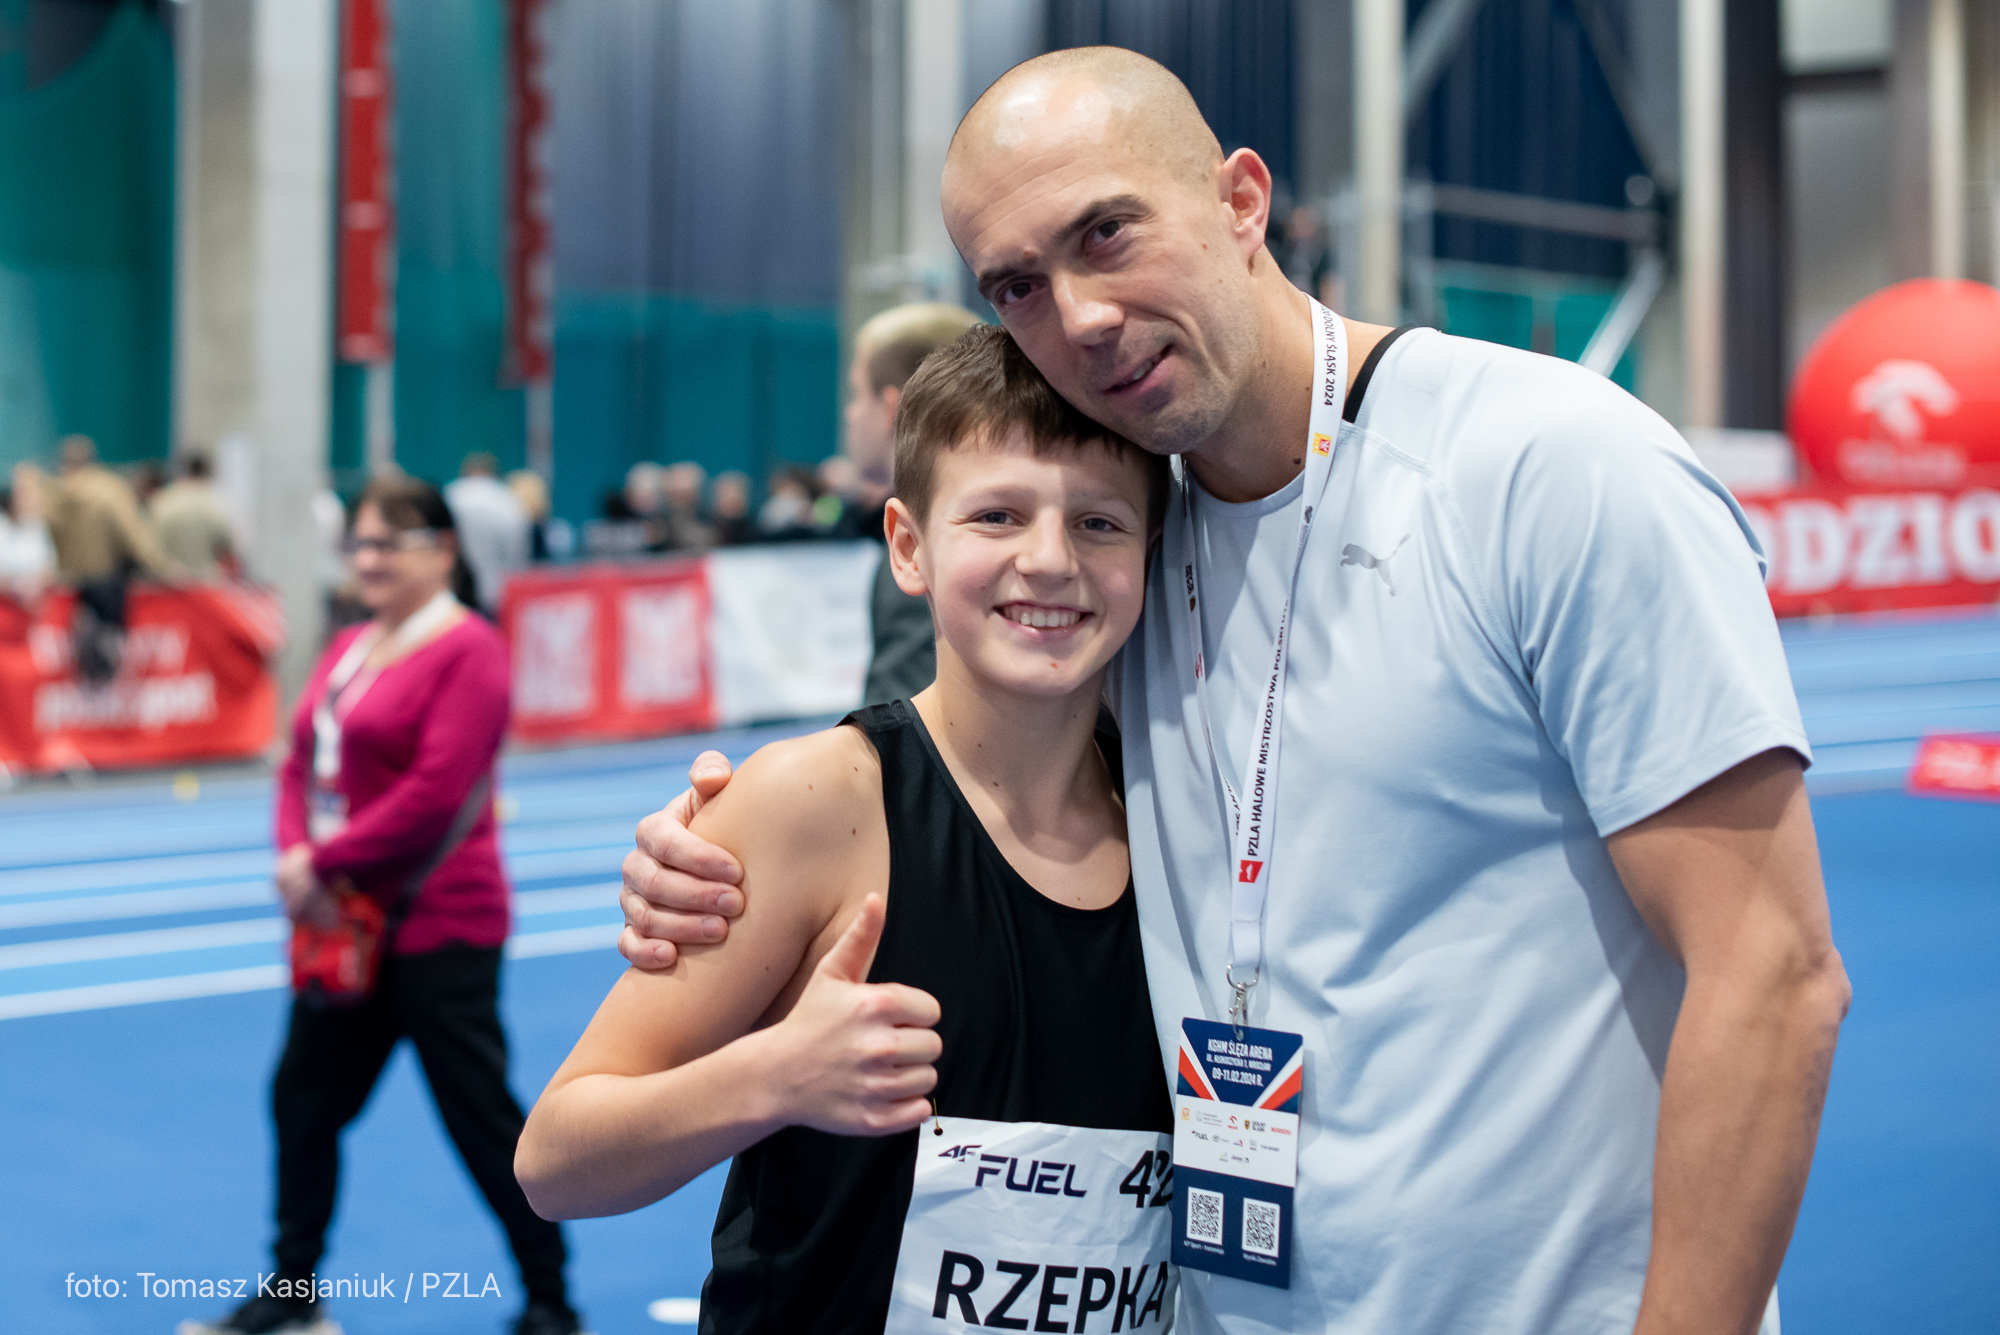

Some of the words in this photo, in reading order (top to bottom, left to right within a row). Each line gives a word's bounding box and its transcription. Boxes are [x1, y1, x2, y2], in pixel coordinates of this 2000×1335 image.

[1323, 315, 1336, 342] DOLNY
[1324, 343, 1338, 376] ŚLĄSK
[1324, 378, 1335, 406] 2024
[1273, 626, 1284, 671] POLSKI
[1258, 674, 1278, 765] MISTRZOSTWA
[1251, 767, 1267, 822] HALOWE
[1247, 825, 1261, 857] PZLA
[1249, 1044, 1273, 1061] ARENA
[1211, 1066, 1257, 1086] 09-11.02.2024
[974, 1153, 1088, 1198] FUEL
[932, 1249, 1168, 1335] RZEPKA
